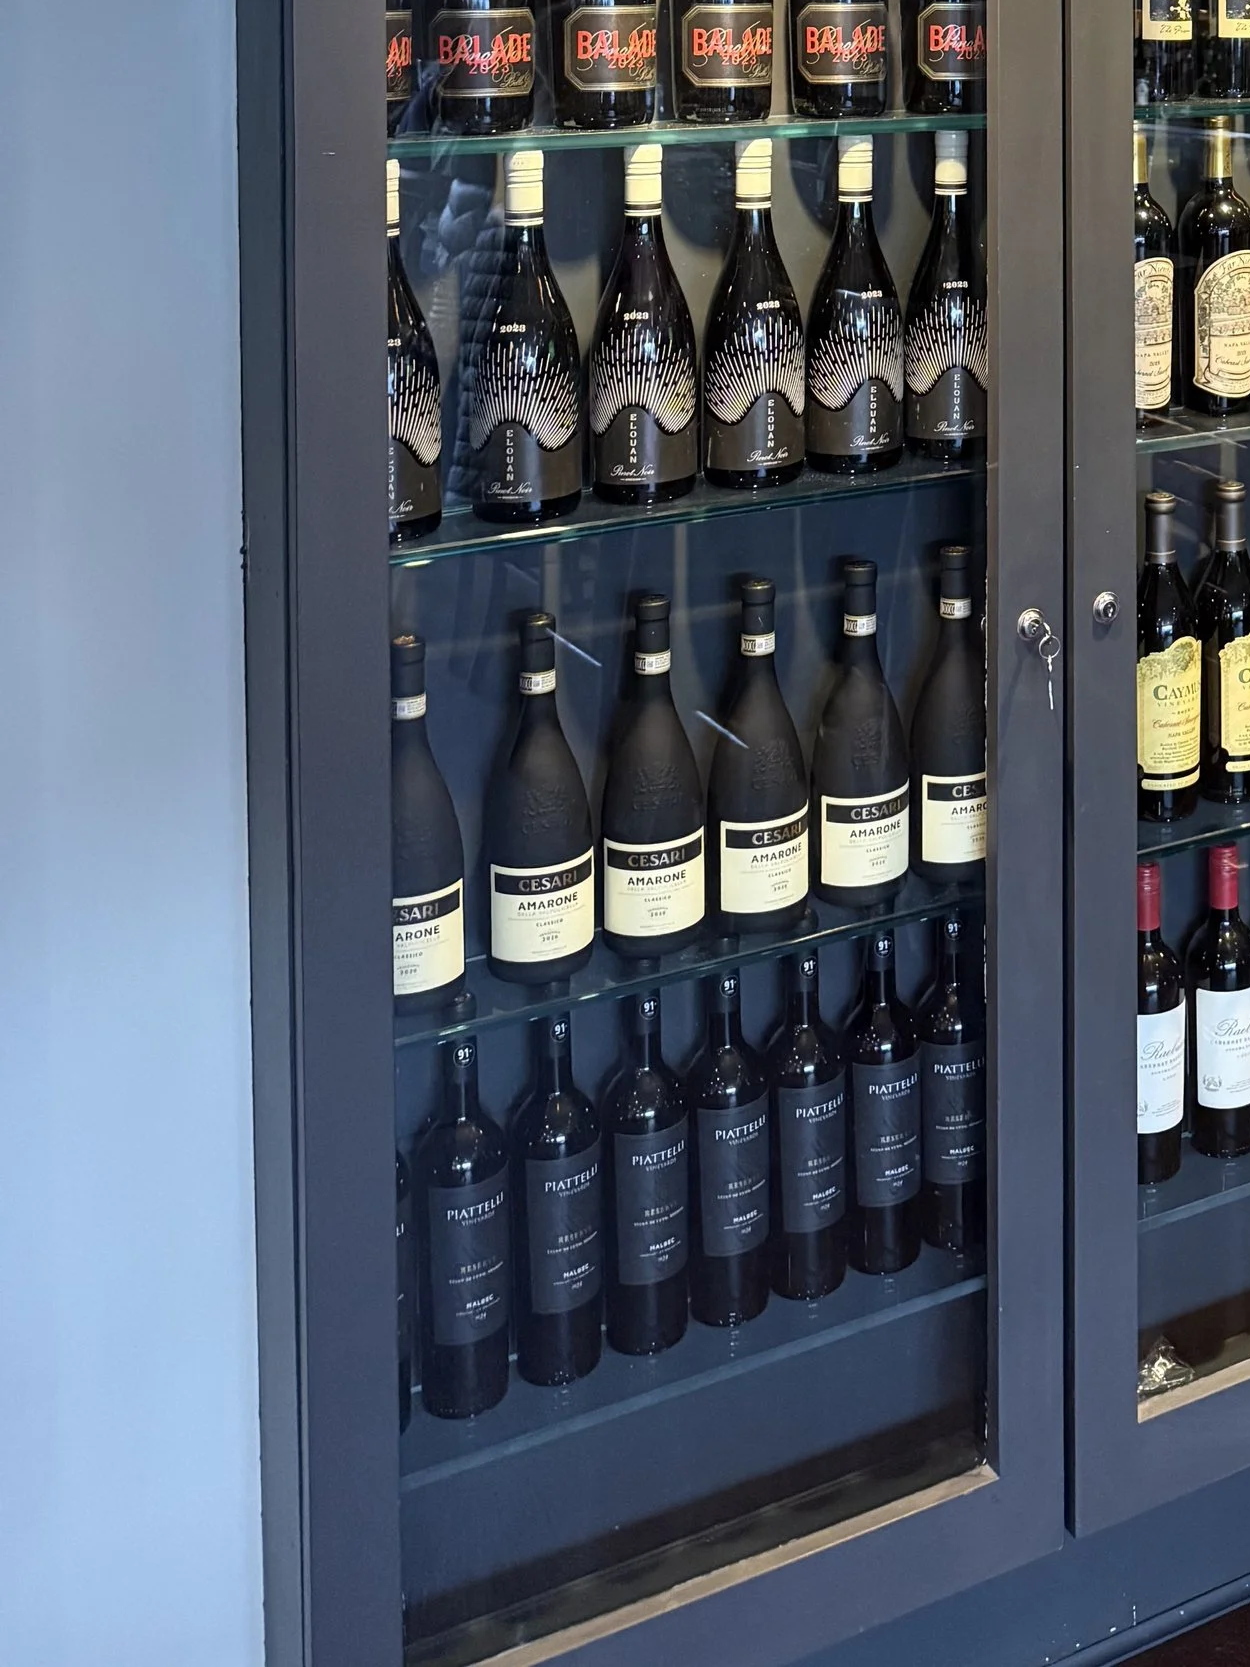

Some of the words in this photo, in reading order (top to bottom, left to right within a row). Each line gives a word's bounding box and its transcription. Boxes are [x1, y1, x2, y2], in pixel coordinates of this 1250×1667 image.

[438, 33, 531, 65] BALADE
[806, 25, 886, 54] BALADE
[861, 290, 882, 299] 2023
[948, 281, 968, 289] 2023
[623, 311, 649, 321] 2023
[756, 300, 780, 310] 2023
[500, 323, 526, 333] 2023
[767, 399, 775, 448] ELOUAN
[629, 413, 637, 463] ELOUAN
[506, 429, 514, 481] ELOUAN
[850, 801, 901, 821] CESARI
[751, 821, 801, 846] CESARI
[850, 820, 901, 839] AMARONE
[627, 848, 686, 868] CESARI
[751, 842, 802, 864] AMARONE
[518, 870, 577, 892] CESARI
[627, 869, 687, 886] AMARONE
[518, 892, 578, 912] AMARONE
[869, 1072, 918, 1095] PIATTELLI
[796, 1093, 844, 1119] PIATTELLI
[715, 1114, 766, 1141] PIATTELLI
[632, 1139, 685, 1166] PIATTELLI
[544, 1164, 598, 1193] PIATTELLI
[447, 1191, 503, 1221] PIATTELLI
